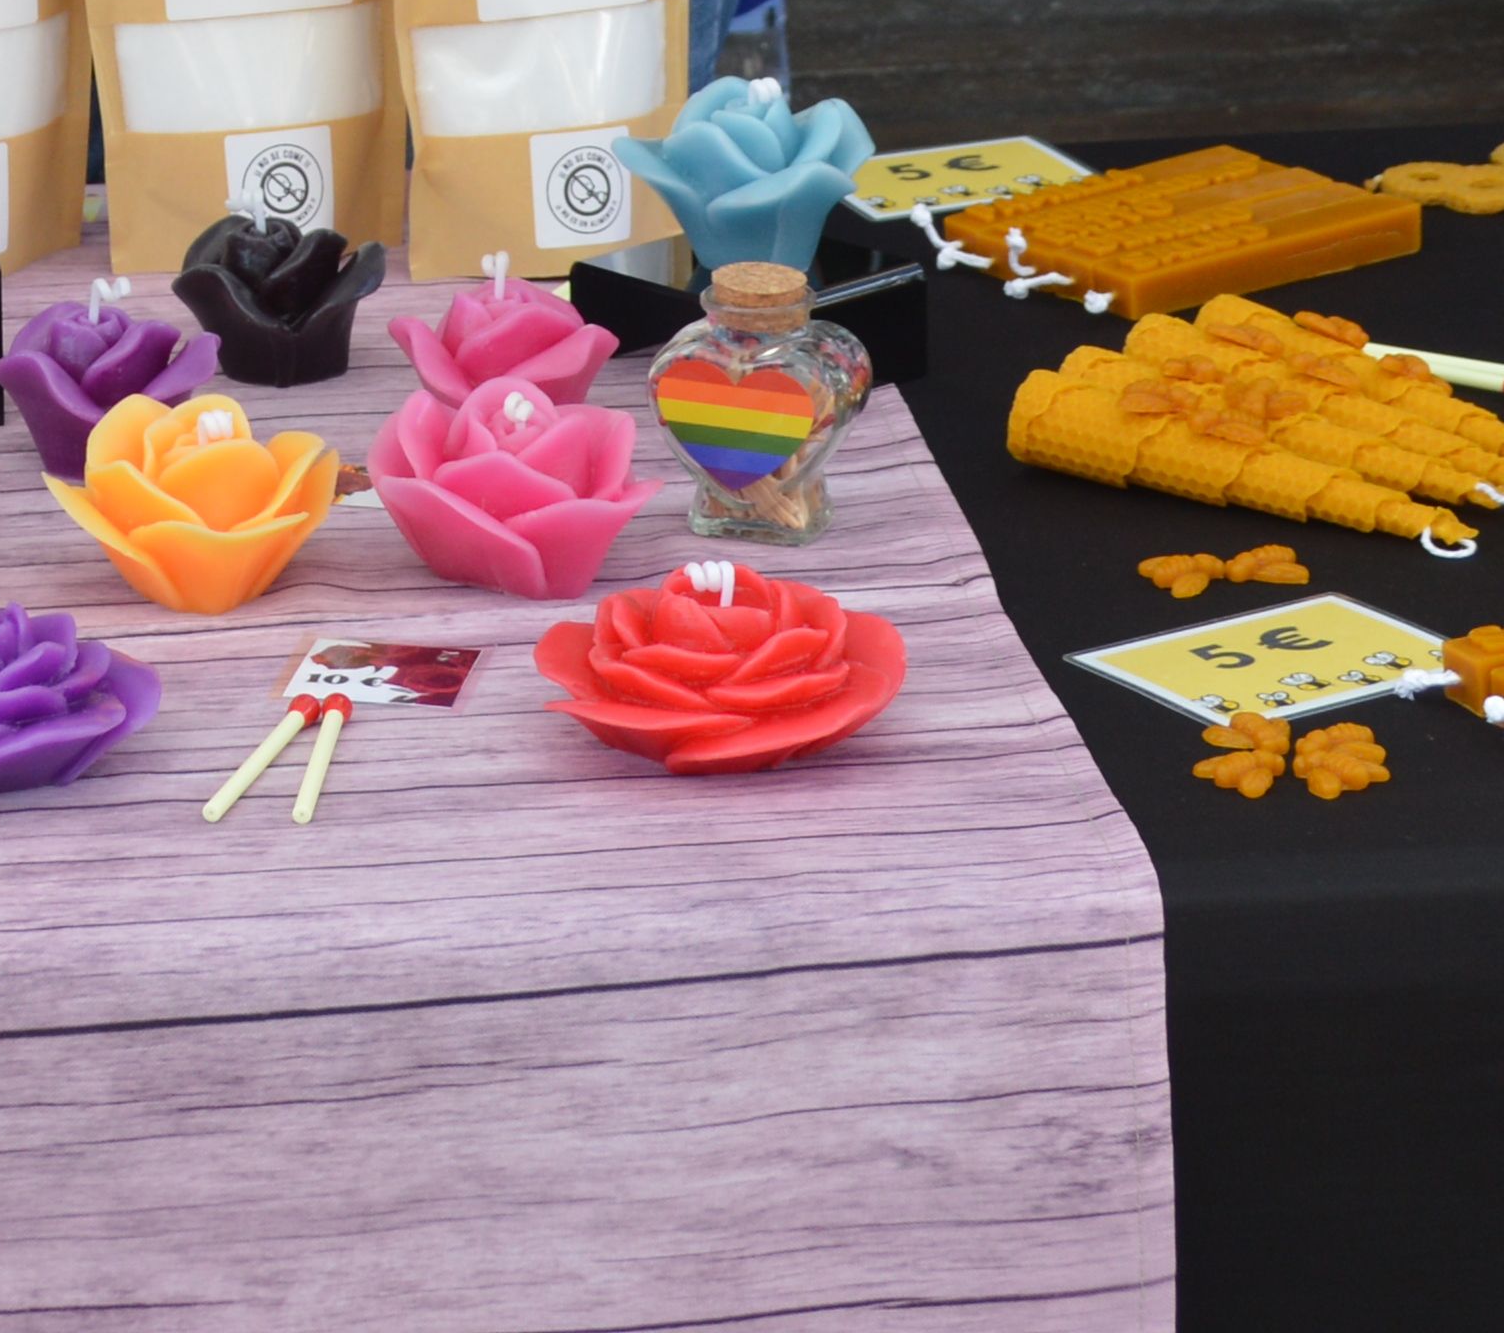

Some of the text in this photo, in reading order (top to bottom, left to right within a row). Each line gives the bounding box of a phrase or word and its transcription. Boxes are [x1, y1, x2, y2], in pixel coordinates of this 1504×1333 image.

[885, 154, 1000, 182] 5 €
[1188, 625, 1333, 671] 5 €
[306, 673, 350, 685] 10
